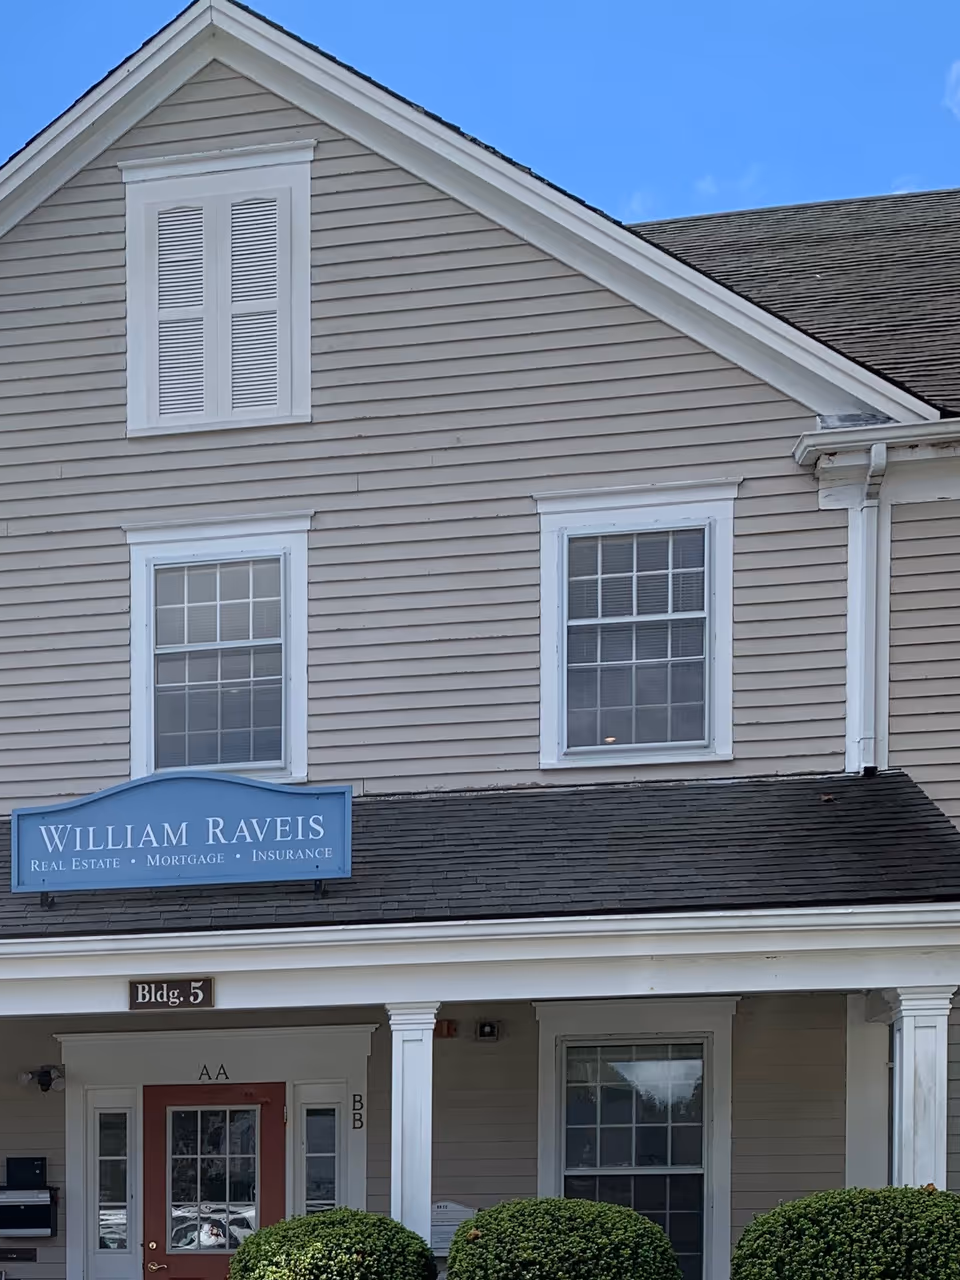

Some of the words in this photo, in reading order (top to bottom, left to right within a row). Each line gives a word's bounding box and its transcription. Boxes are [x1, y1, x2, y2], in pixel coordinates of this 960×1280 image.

[39, 822, 188, 853] WILLIAM
[205, 814, 325, 845] RAVEIS
[30, 859, 67, 872] REAL
[71, 857, 120, 870] ESTATE
[146, 853, 225, 867] MORTGAGE
[252, 847, 333, 862] INSURANCE
[135, 983, 184, 1006] Bldg.
[189, 981, 204, 1004] 5
[198, 1063, 230, 1081] AA
